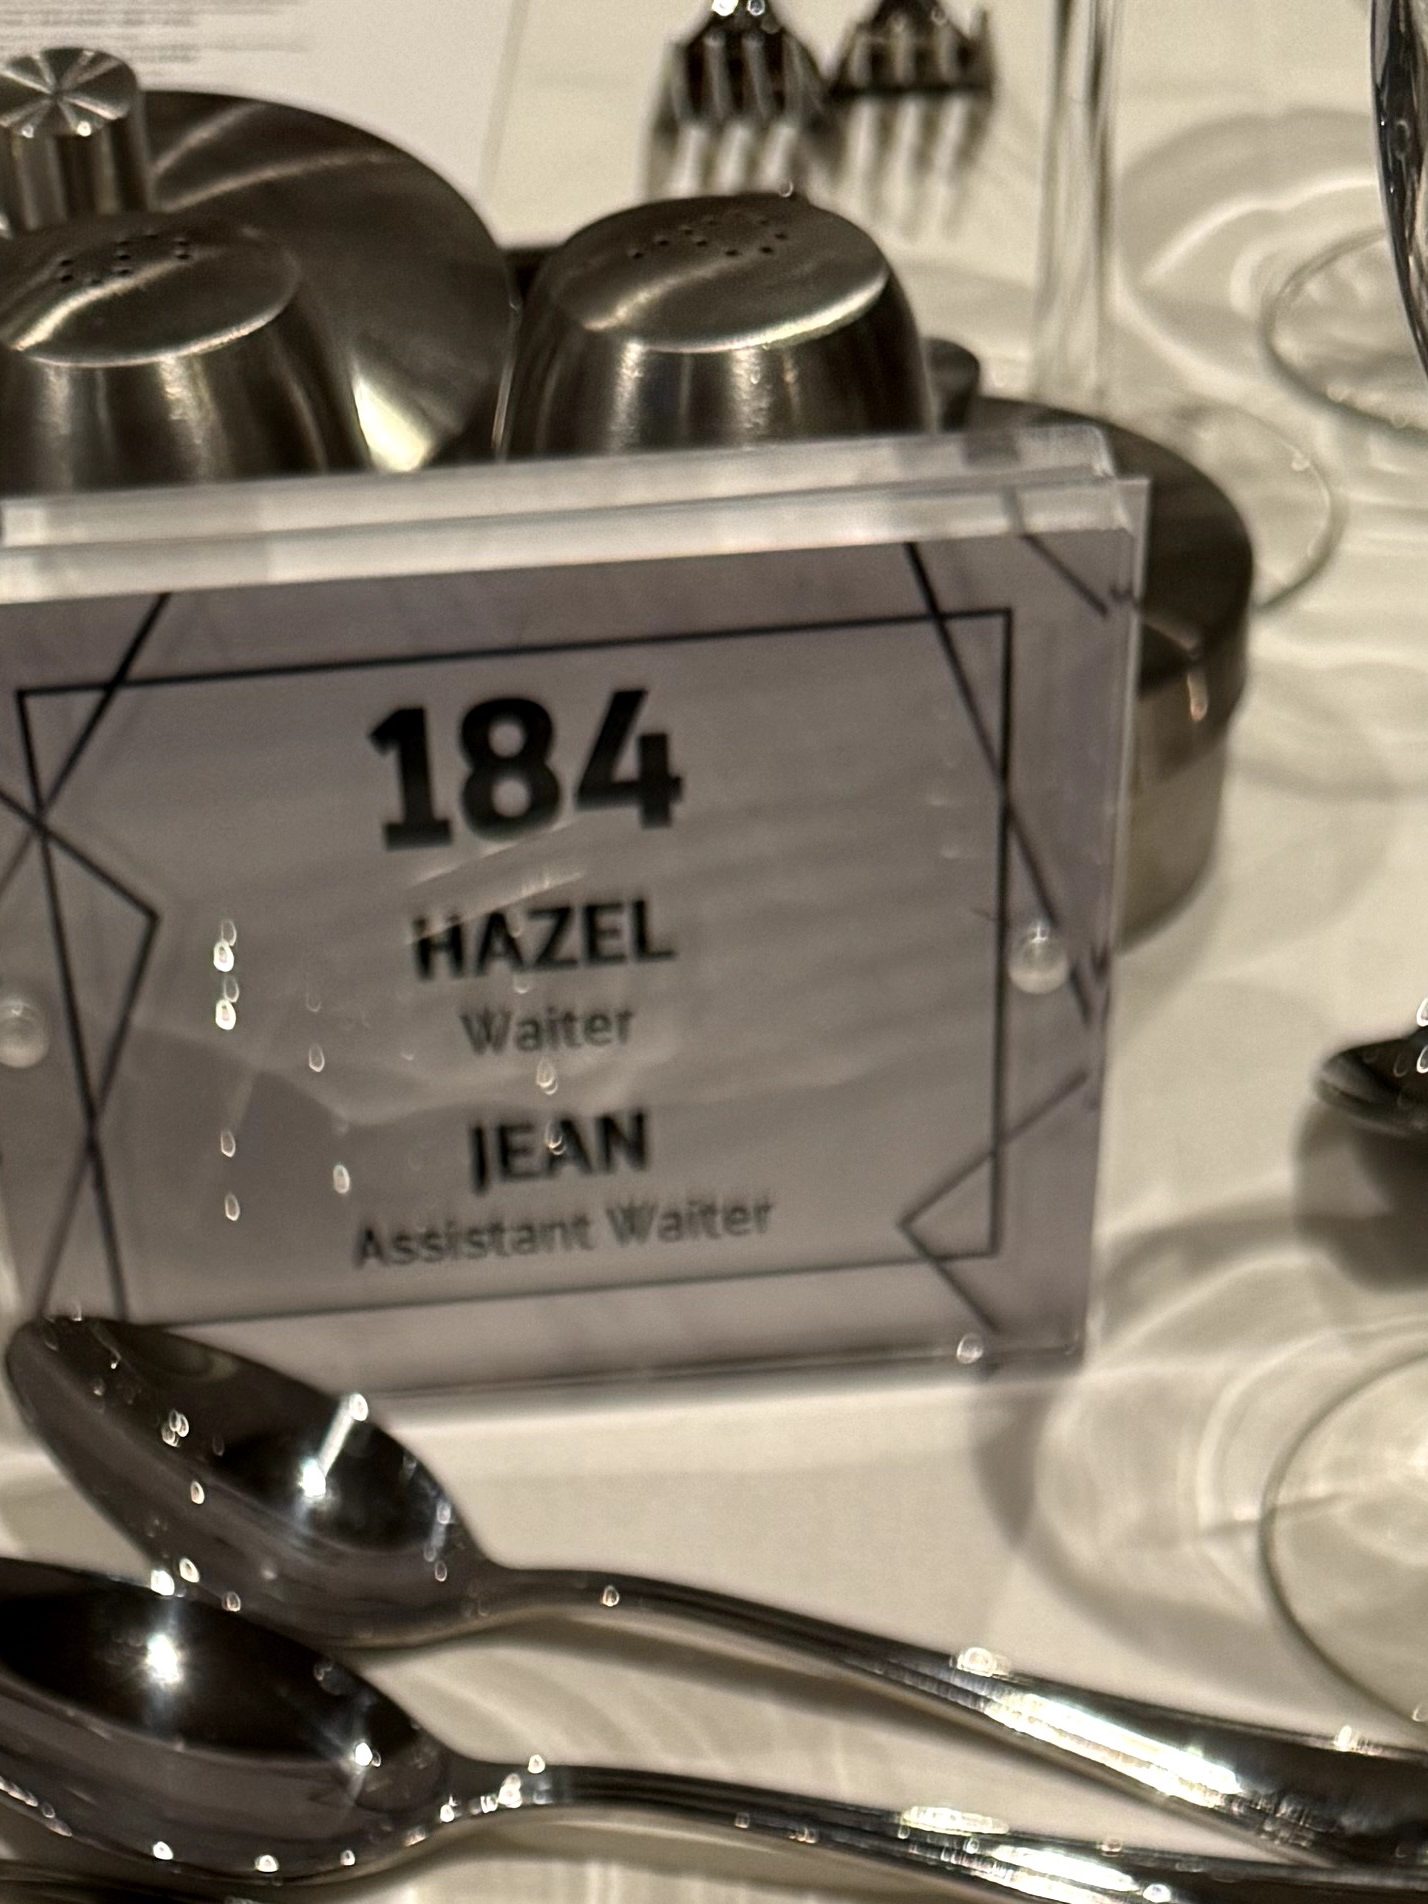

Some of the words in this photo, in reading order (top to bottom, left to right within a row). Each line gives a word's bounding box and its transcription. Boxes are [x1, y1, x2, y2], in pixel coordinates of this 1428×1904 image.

[367, 687, 684, 850] 184
[411, 897, 676, 980] HAZEL
[459, 1004, 635, 1055] Waiter
[471, 1109, 647, 1194] JEAN
[354, 1208, 593, 1268] Assistant
[606, 1196, 775, 1247] Waiter
